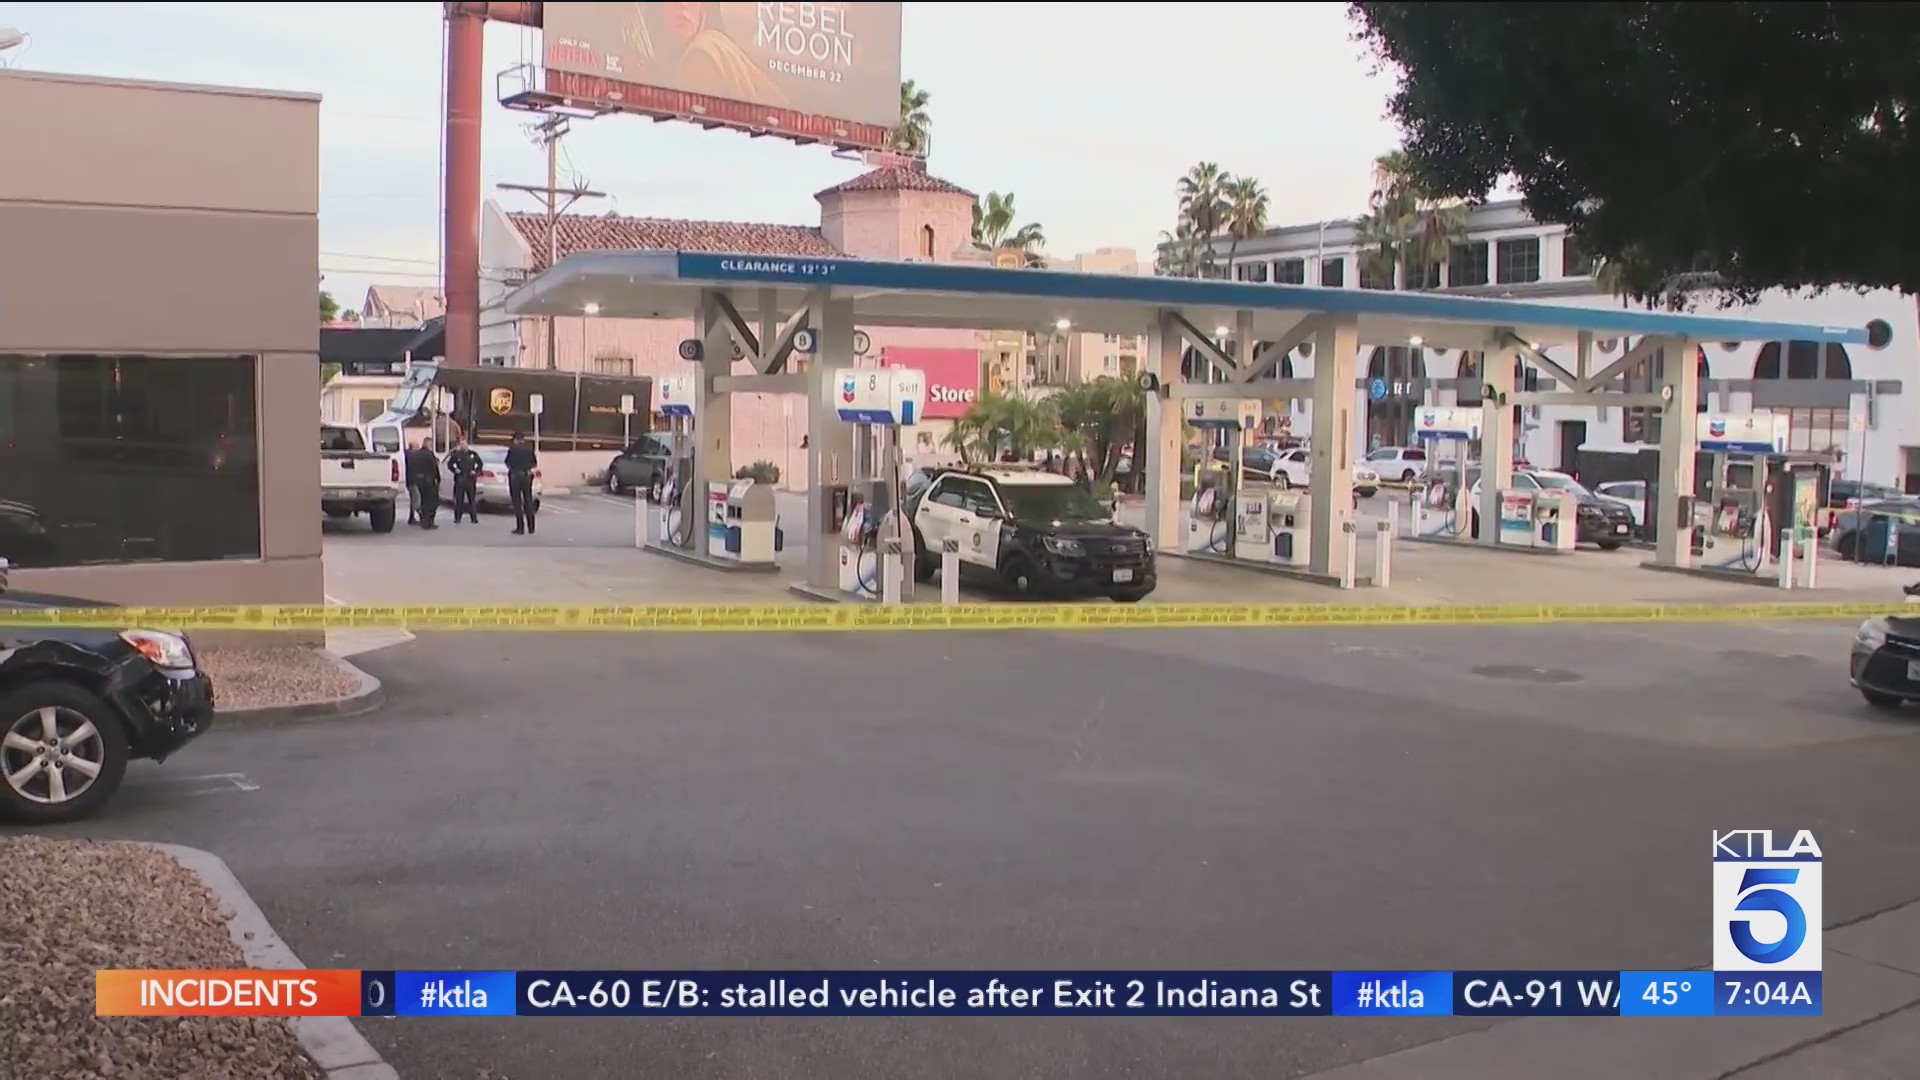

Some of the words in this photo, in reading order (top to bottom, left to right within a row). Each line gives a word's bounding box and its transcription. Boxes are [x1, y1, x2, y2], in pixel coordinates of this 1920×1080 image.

[757, 2, 855, 39] REBEL
[758, 20, 852, 66] MOON
[549, 43, 597, 68] NETFLIX
[768, 59, 826, 80] DECEMBER
[829, 70, 842, 82] 22
[720, 260, 795, 273] CLEARANCE
[798, 334, 807, 347] 8
[856, 337, 863, 349] 7
[869, 373, 877, 391] 8
[898, 382, 919, 394] Self
[930, 384, 976, 403] Store
[1745, 418, 1754, 429] 4
